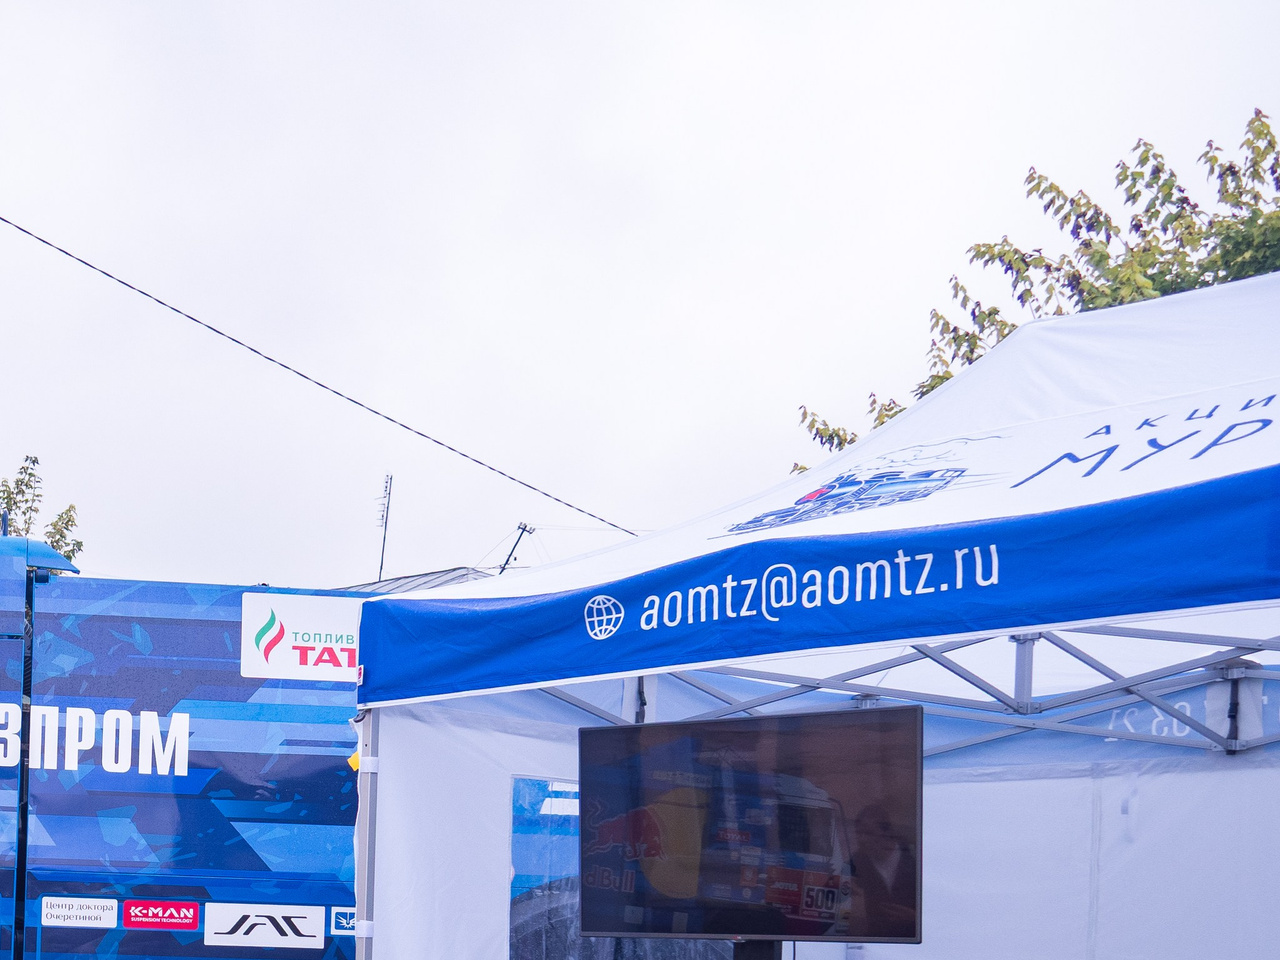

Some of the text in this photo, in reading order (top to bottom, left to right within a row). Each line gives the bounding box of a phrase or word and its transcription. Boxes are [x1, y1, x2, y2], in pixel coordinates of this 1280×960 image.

[639, 544, 999, 631] aomtz@aomtz.ru
[292, 631, 355, 644] ТОПЛИВ
[45, 901, 114, 912] Центр доктора
[129, 906, 194, 918] K-MAN
[45, 913, 102, 922] Очеретиной
[214, 914, 317, 938] JAC
